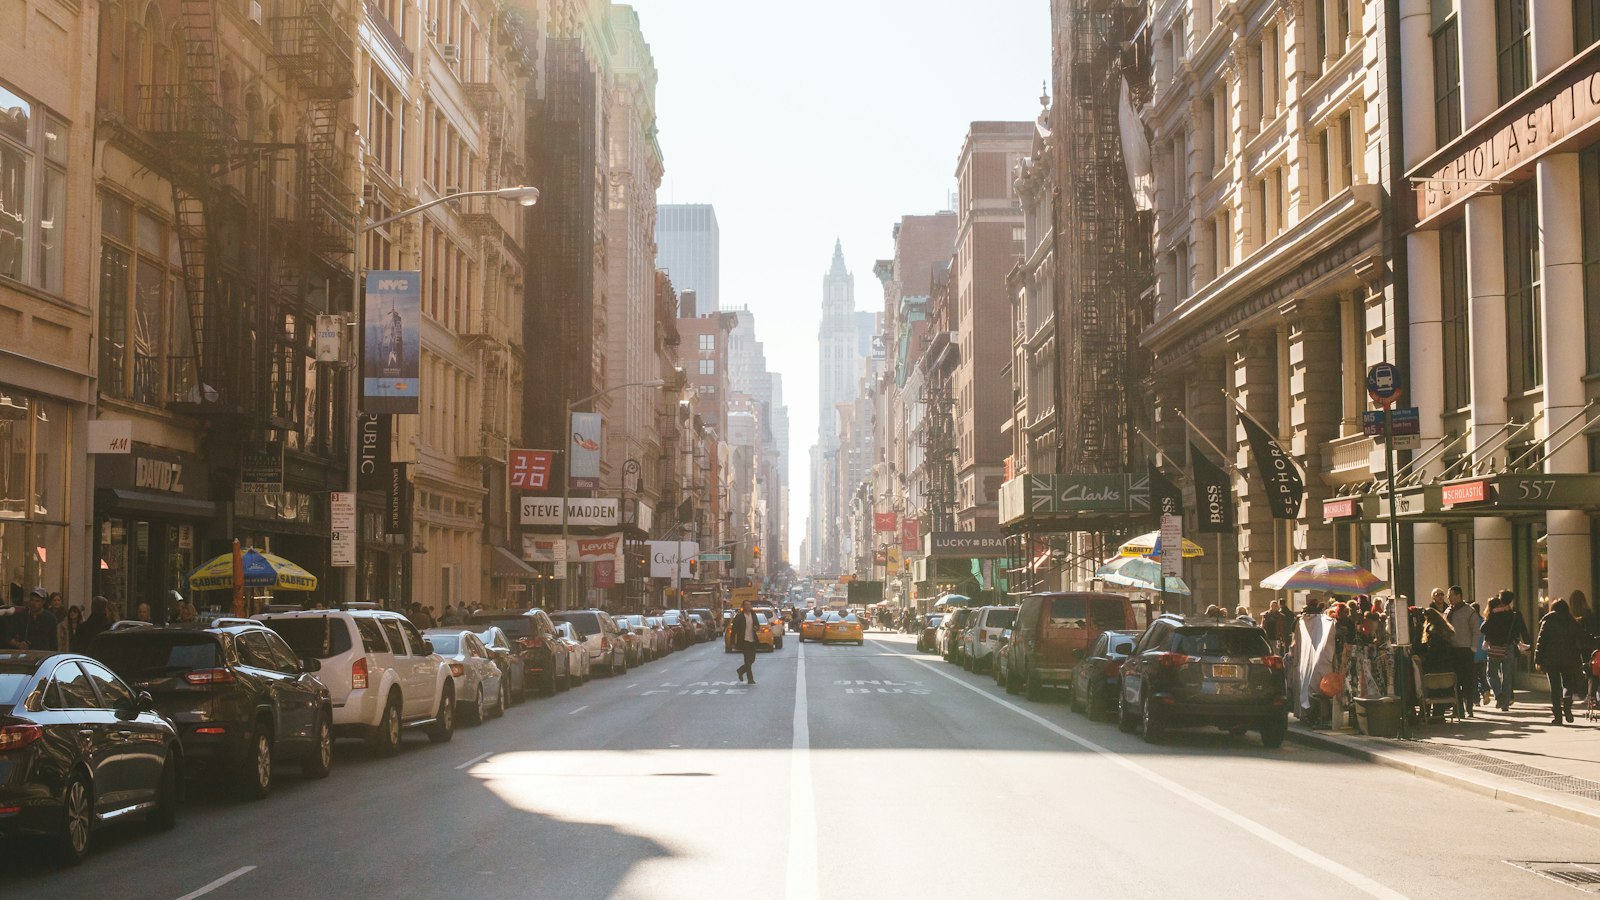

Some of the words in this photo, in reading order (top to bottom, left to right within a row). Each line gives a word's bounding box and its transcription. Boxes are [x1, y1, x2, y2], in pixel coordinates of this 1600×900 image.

[378, 279, 408, 291] NYC
[1364, 413, 1376, 422] M5
[1365, 425, 1376, 434] M5
[109, 438, 128, 450] H&M
[1061, 484, 1120, 501] Clarks
[1448, 486, 1482, 500] SCHOLASTIC
[1519, 480, 1556, 499] 557
[332, 493, 338, 501] 3
[1207, 485, 1221, 523] BOSS
[523, 504, 560, 517] STEVE
[567, 505, 615, 518] MADDEN
[333, 532, 339, 540] 2
[936, 539, 972, 547] LUCKY
[280, 575, 315, 587] SABRETT
